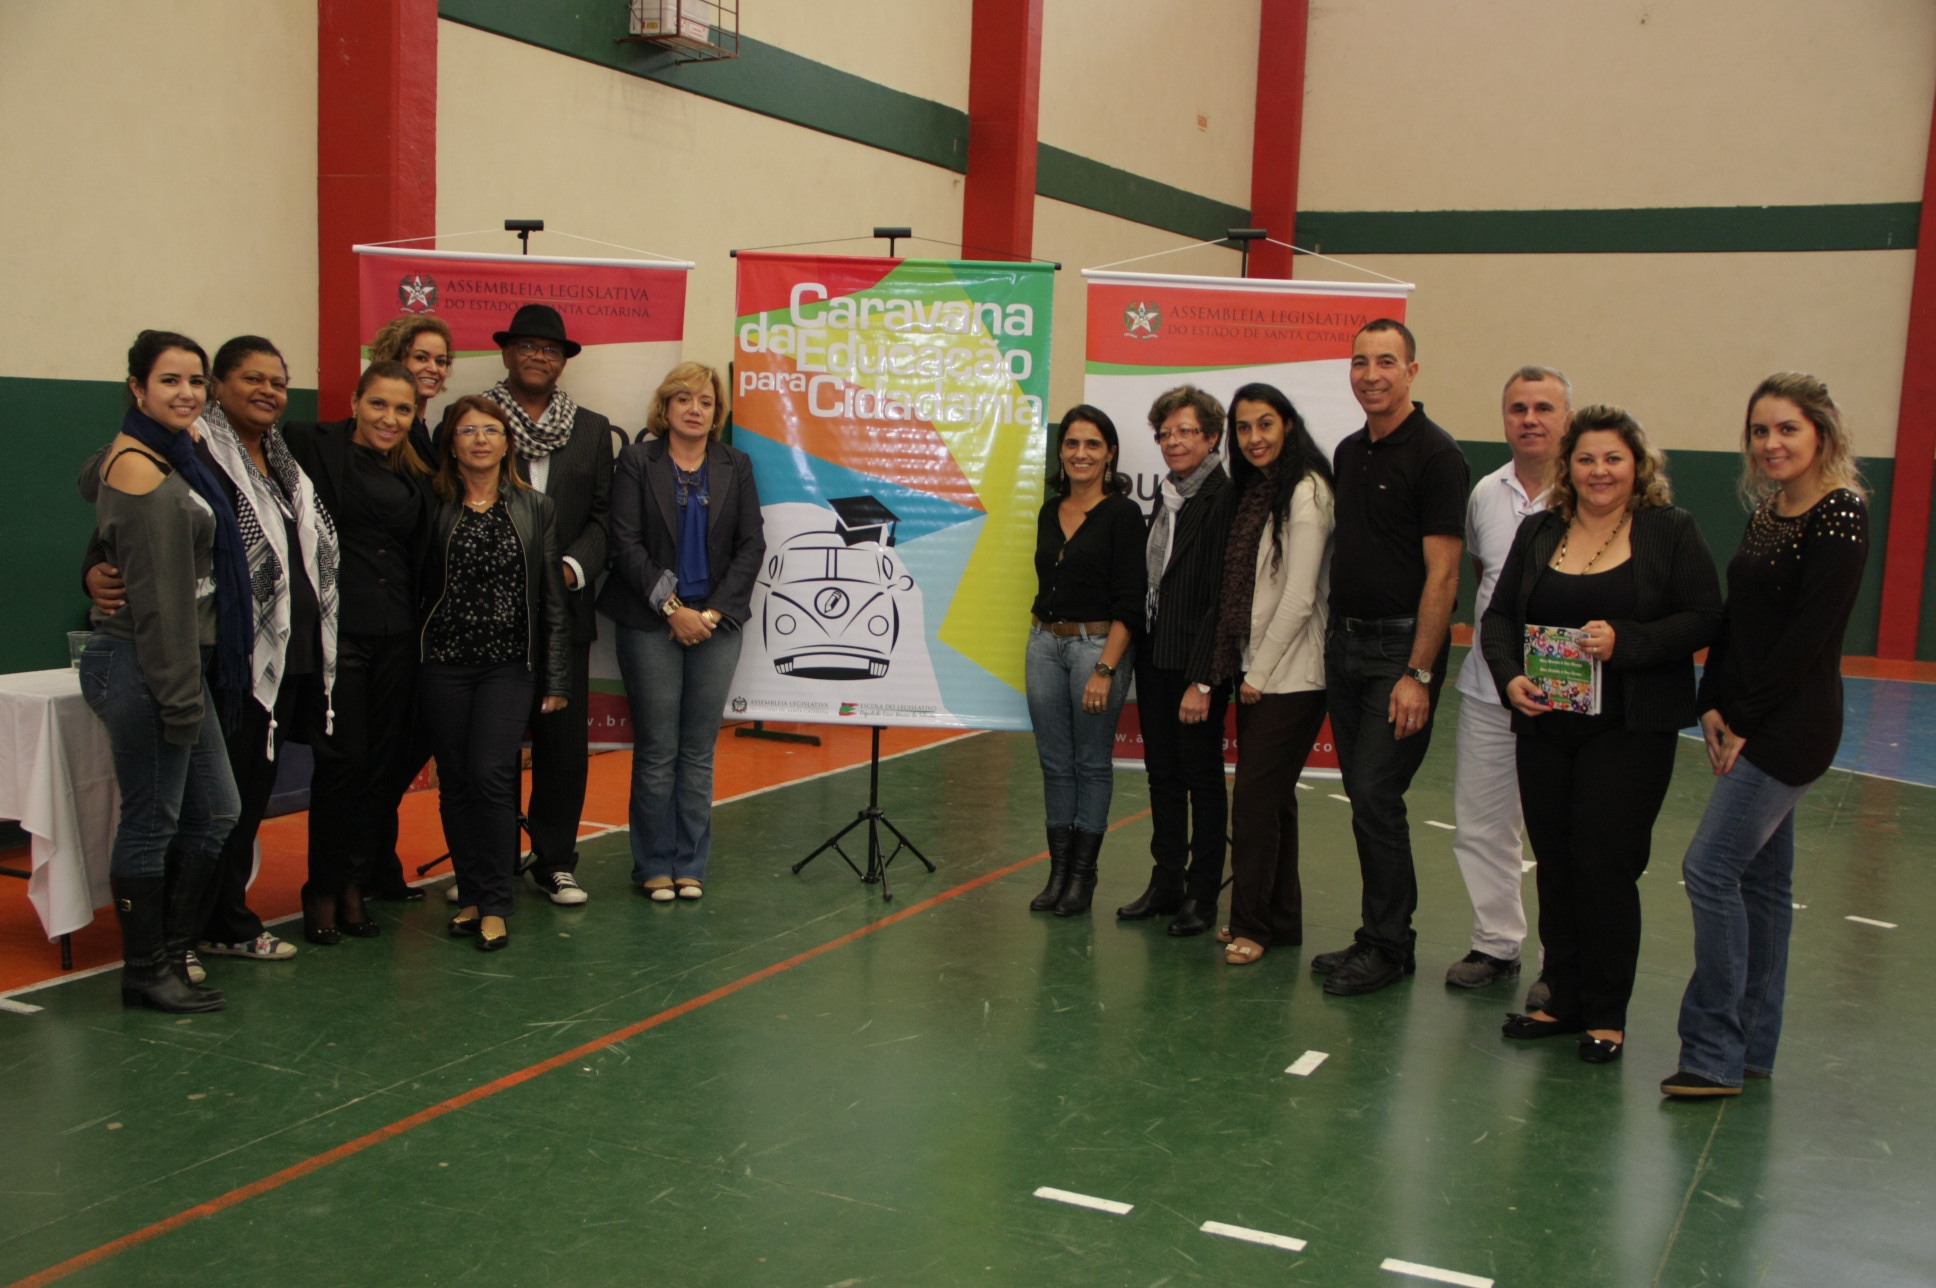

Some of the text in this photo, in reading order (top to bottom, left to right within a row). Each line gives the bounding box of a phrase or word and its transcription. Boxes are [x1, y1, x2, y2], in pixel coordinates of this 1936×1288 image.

[446, 279, 650, 302] ASSEMBLEIA LEGISLATIVA
[445, 298, 465, 310] DO
[469, 300, 518, 312] ESTADO
[586, 305, 650, 319] CATARINA
[789, 282, 1033, 337] Caravana
[1169, 305, 1368, 327] ASSEMBLEIA LEGISLATIVA
[1168, 324, 1188, 336] DO
[1192, 326, 1240, 338] ESTADO
[1243, 327, 1260, 338] DE
[1264, 328, 1302, 341] SANTA
[740, 311, 1033, 382] da Educação
[740, 369, 1044, 427] para Cidadania
